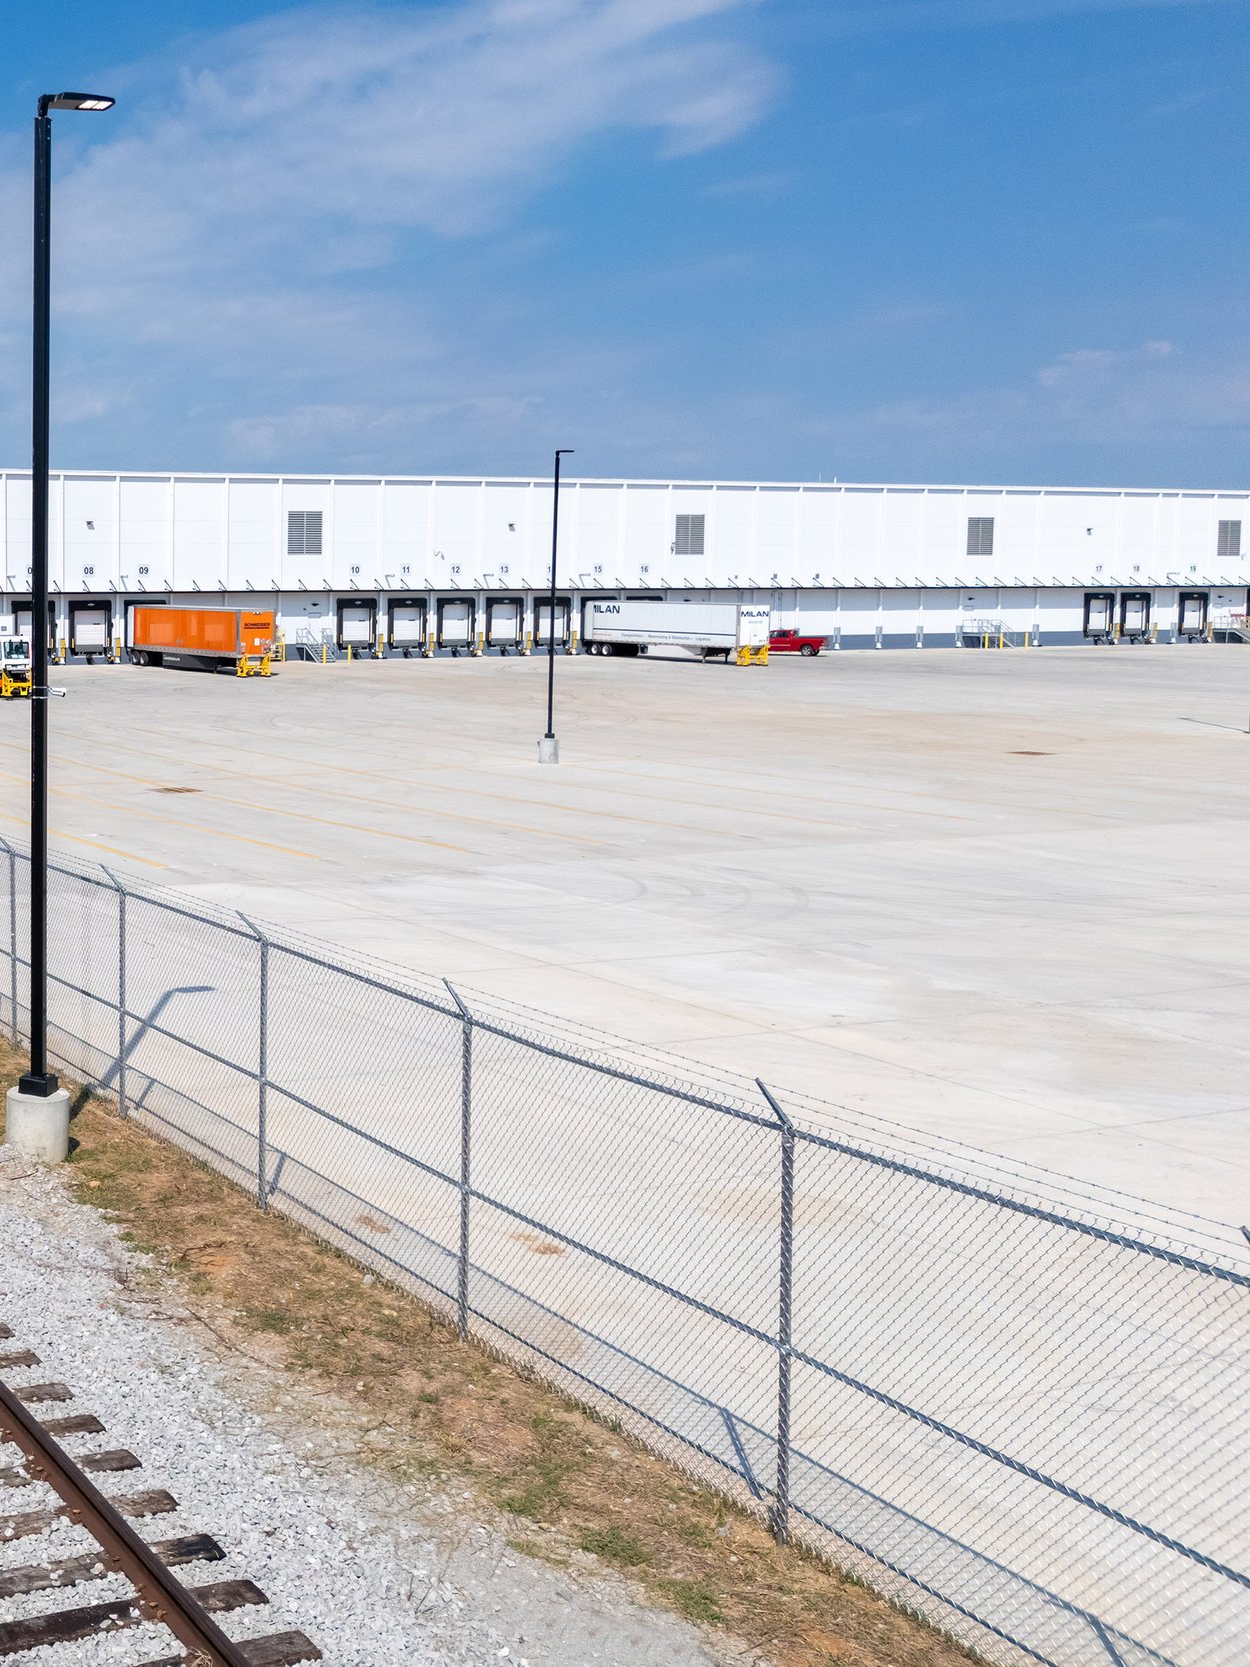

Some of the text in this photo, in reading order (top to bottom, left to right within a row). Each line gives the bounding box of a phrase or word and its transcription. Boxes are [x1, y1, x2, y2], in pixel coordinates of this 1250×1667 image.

[84, 567, 94, 575] 08
[139, 567, 149, 575] 09
[351, 566, 360, 574] 10
[402, 566, 410, 574] 11
[451, 566, 460, 574] 12
[500, 566, 509, 574] 13
